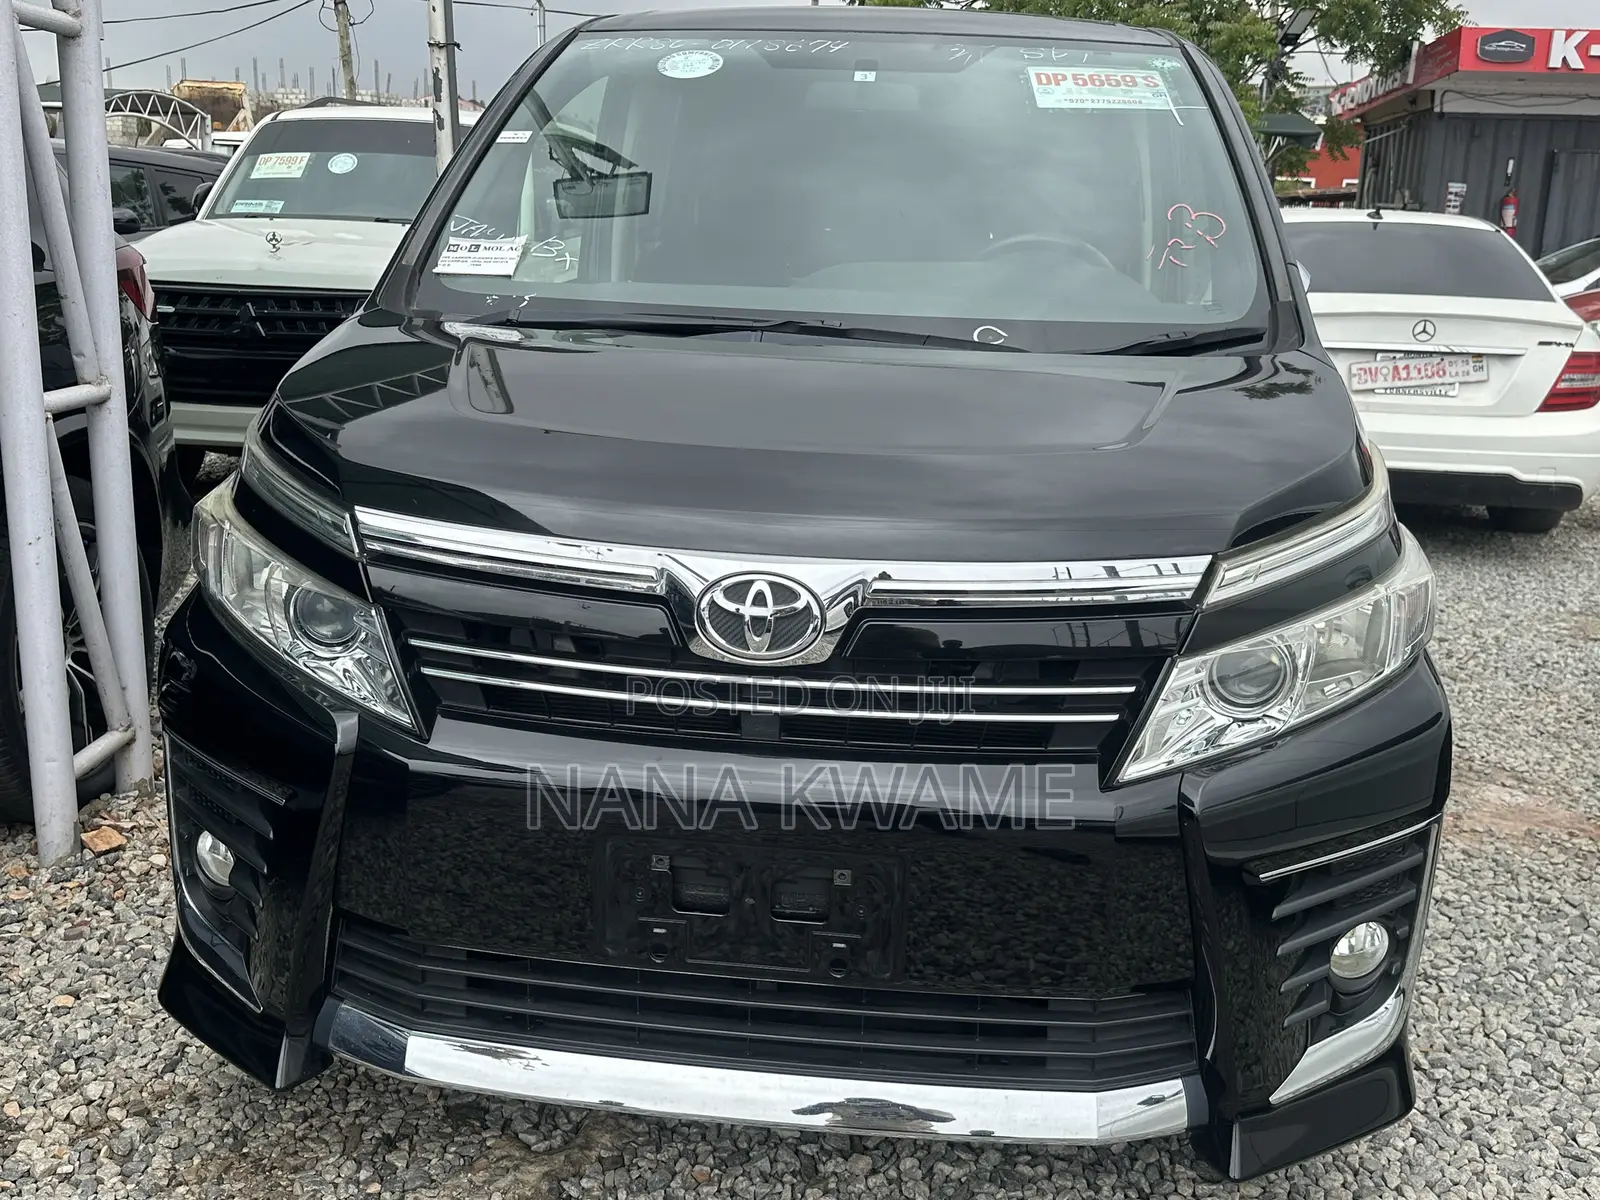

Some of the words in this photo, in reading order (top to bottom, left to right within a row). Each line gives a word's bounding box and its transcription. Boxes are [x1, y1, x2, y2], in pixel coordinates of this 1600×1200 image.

[1034, 72, 1067, 87] DP
[1071, 73, 1138, 88] 5659
[1142, 75, 1160, 88] S
[258, 156, 272, 166] DP
[273, 155, 298, 165] 7599
[299, 155, 307, 165] F
[483, 244, 506, 252] MOL
[1472, 364, 1485, 373] GH
